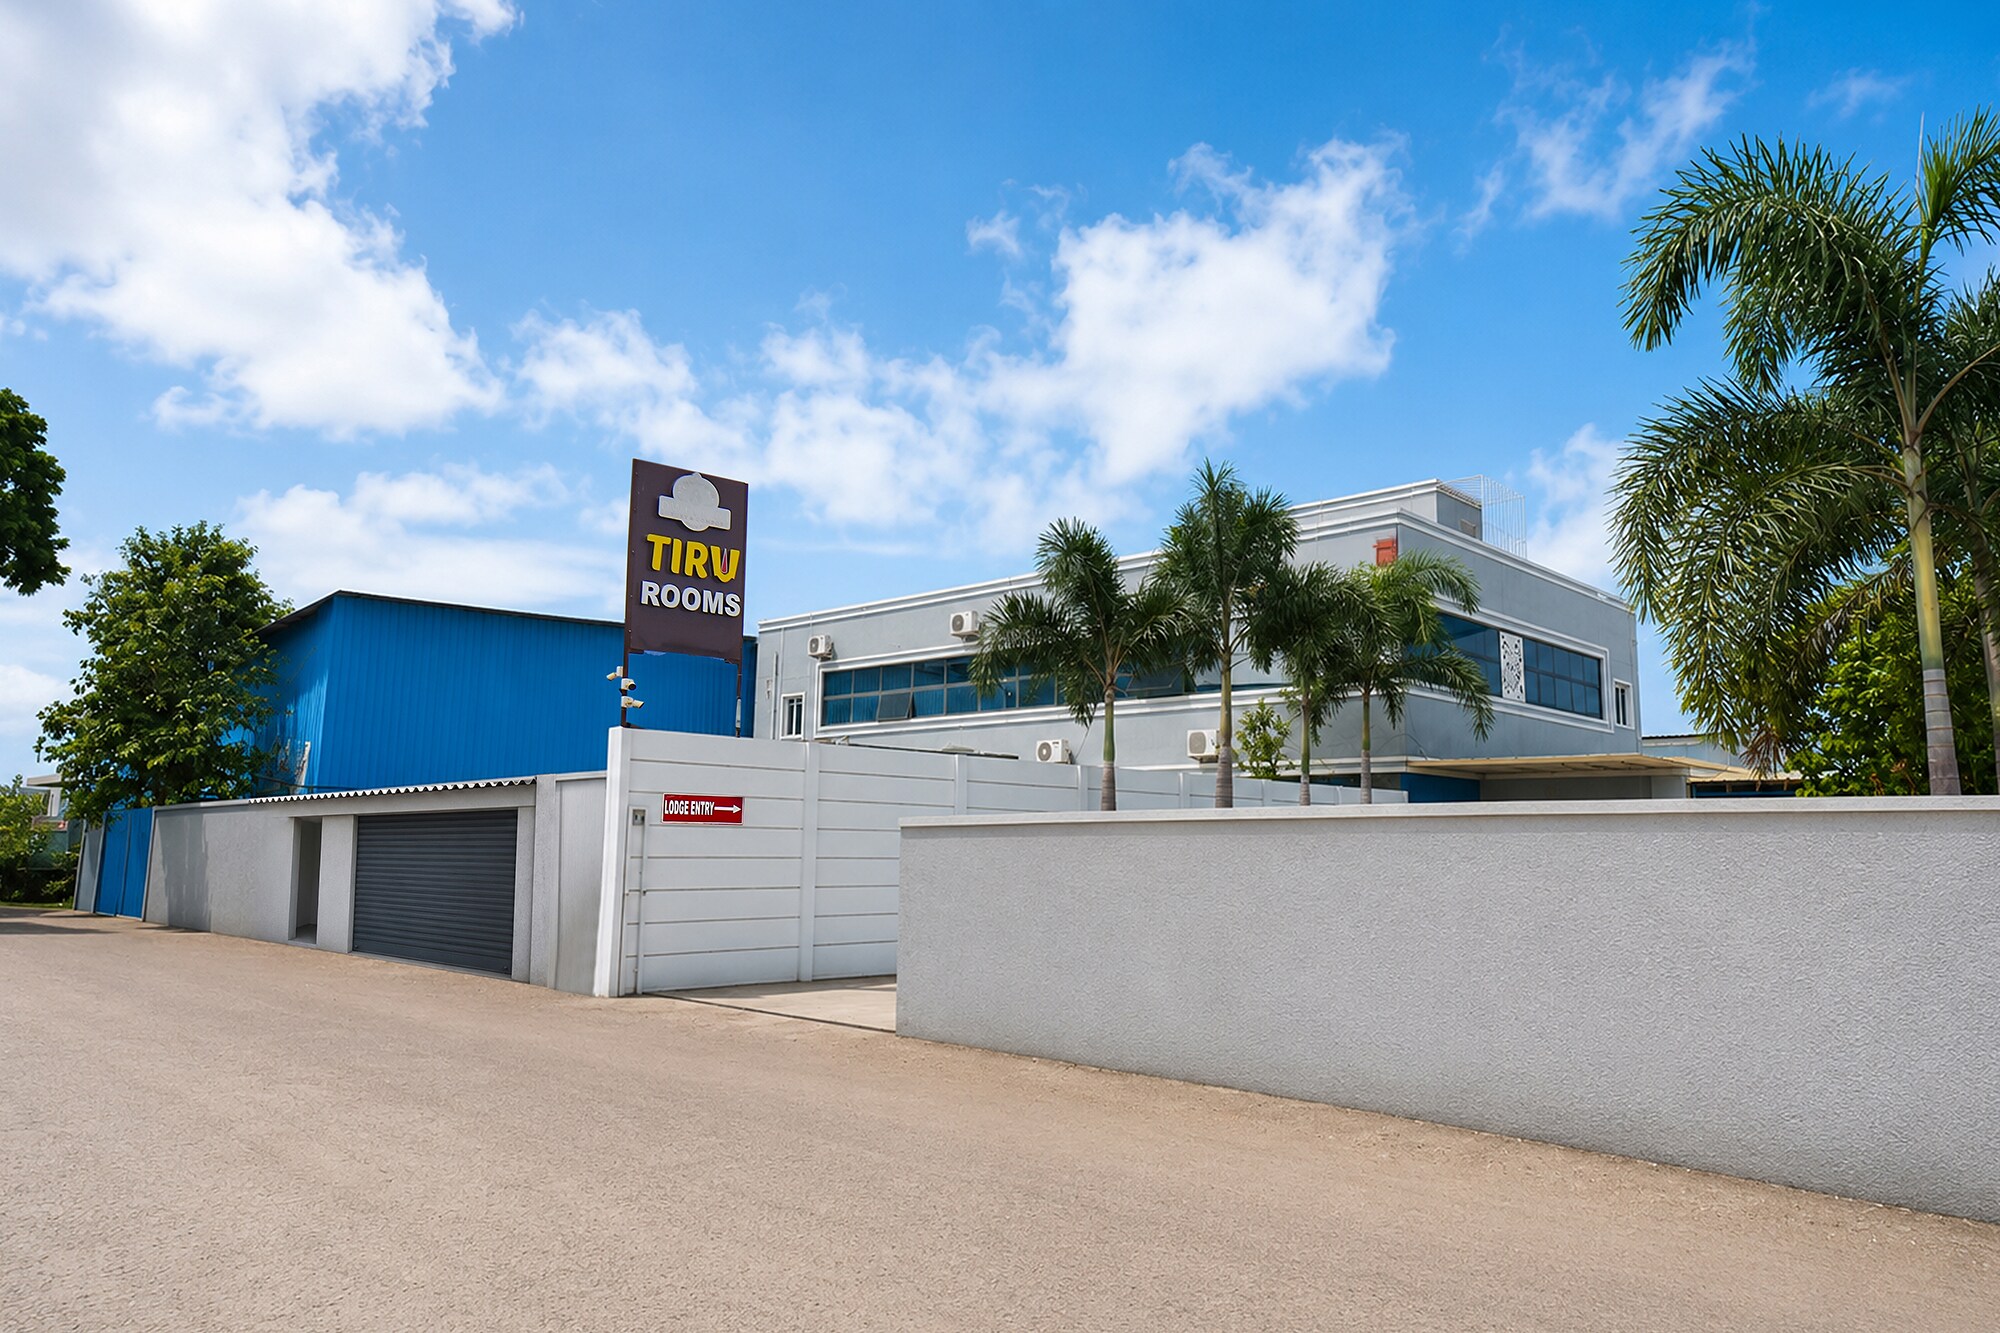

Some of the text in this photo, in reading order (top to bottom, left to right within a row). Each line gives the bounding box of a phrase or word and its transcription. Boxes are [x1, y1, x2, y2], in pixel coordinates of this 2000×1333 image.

[646, 533, 741, 583] TIRU
[641, 580, 741, 617] ROOMS
[664, 800, 715, 816] LODGE ENTRY
